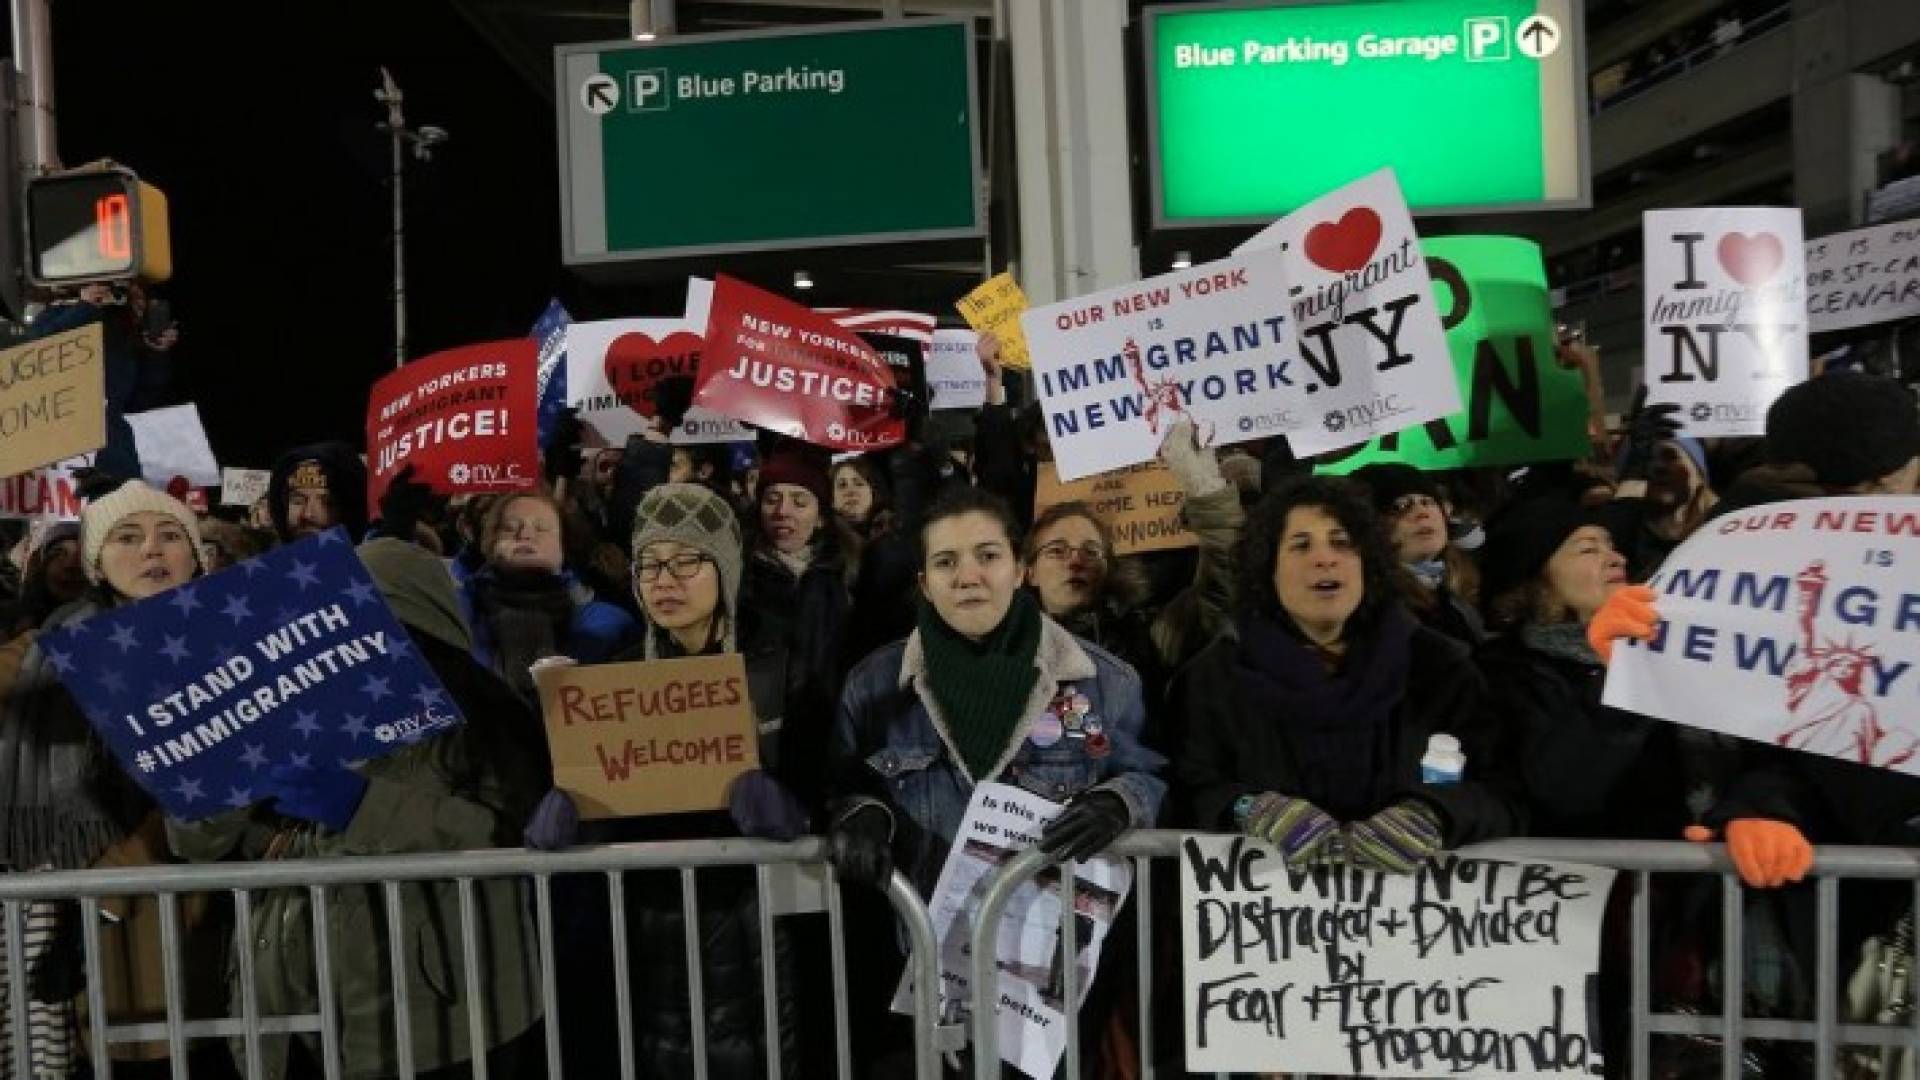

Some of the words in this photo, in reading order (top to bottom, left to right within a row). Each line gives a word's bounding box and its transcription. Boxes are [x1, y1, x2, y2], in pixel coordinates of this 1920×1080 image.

[1174, 43, 1235, 68] Blue
[1242, 37, 1348, 65] Parking
[1356, 33, 1458, 60] Garage
[677, 73, 735, 98] Blue
[742, 66, 846, 94] Parking
[95, 193, 131, 259] 10
[1672, 232, 1707, 290] I
[1056, 306, 1104, 330] OUR
[1113, 288, 1170, 316] NEW
[1179, 268, 1249, 298] YORK
[742, 313, 792, 338] NEW
[1148, 318, 1164, 331] IS
[417, 361, 508, 399] YORKERS
[728, 356, 884, 410] JUSTICE!
[1053, 394, 1145, 437] NEW
[1176, 360, 1294, 406] YORK
[375, 408, 510, 476] JUSTICE!
[1144, 490, 1185, 508] HER
[1718, 511, 1798, 536] OUR
[1811, 512, 1920, 537] NEW
[1863, 550, 1895, 567] IS
[126, 714, 145, 736] I
[148, 655, 255, 728] STAND
[255, 604, 350, 663] WITH
[134, 631, 389, 774] #IMMIGRANTNY
[558, 676, 742, 726] REFUGEES
[594, 734, 744, 781] WELCOME
[974, 820, 998, 835] we
[1003, 828, 1039, 845] wan
[1376, 908, 1406, 938] +
[1002, 993, 1051, 1027] better
[1196, 972, 1295, 1049] Fear
